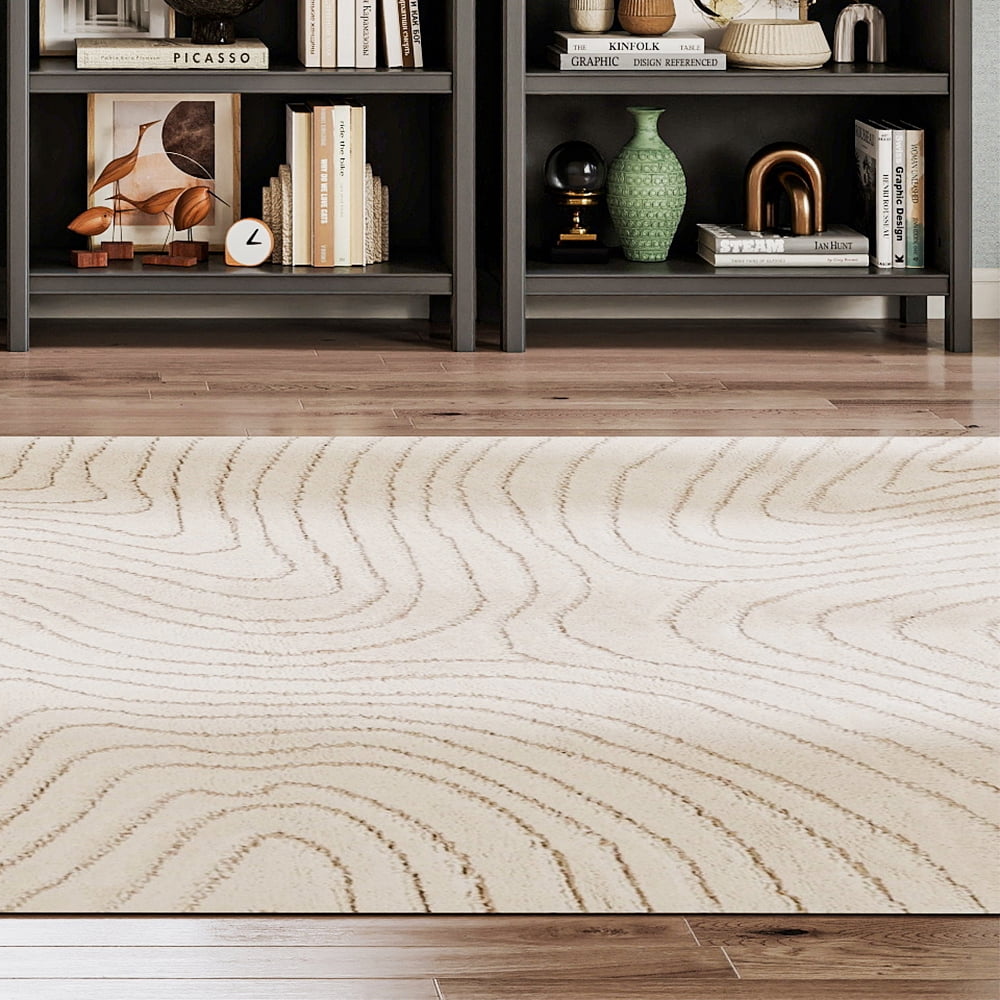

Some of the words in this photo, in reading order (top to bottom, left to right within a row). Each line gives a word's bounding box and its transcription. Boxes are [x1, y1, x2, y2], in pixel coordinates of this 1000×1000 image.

[411, 10, 419, 26] КАК
[360, 5, 371, 56] Карамазовы
[609, 42, 660, 51] KINFOLK
[174, 52, 250, 63] PICASSO
[571, 56, 619, 67] GRAPHIC
[665, 58, 718, 67] REFERENCED
[911, 143, 919, 169] WOMAN
[894, 166, 904, 204] Graphic
[894, 208, 904, 241] Design
[720, 239, 785, 253] STEAM
[814, 241, 829, 250] IAN
[830, 241, 853, 250] HUNT
